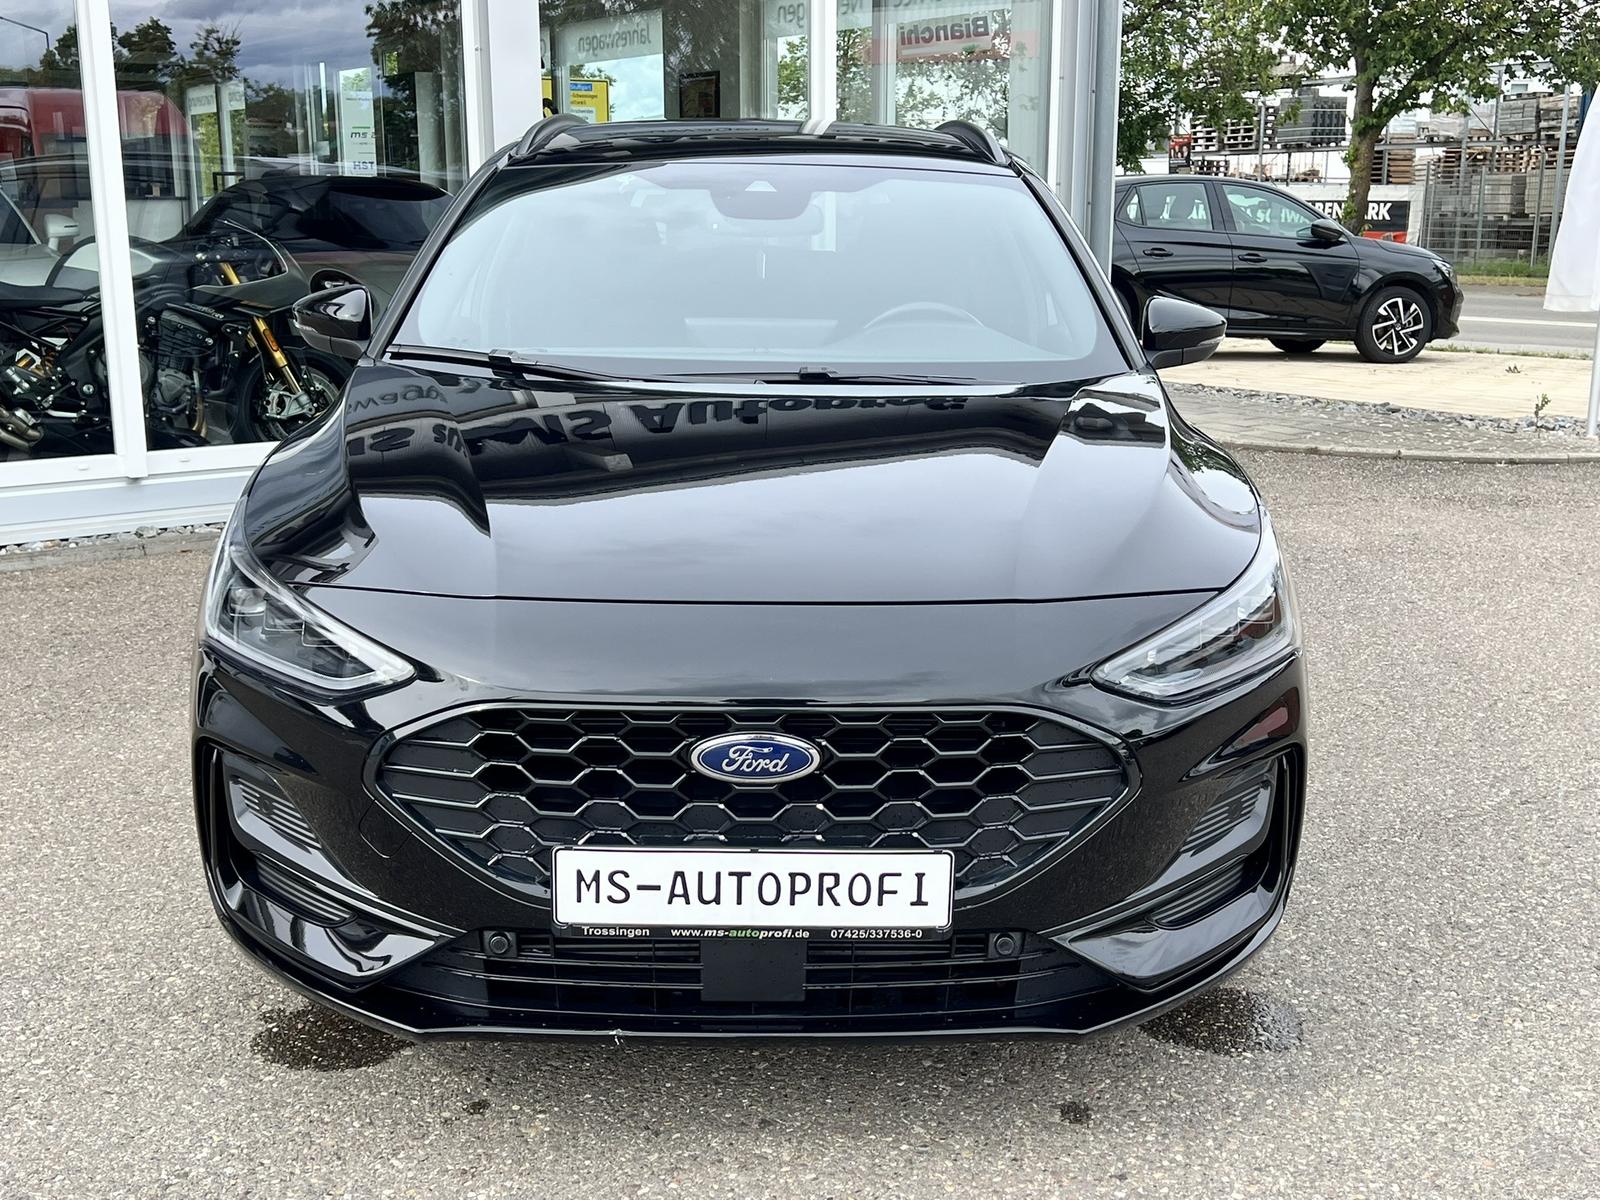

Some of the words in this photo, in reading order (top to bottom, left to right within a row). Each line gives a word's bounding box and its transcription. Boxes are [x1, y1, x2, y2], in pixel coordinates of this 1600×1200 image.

[721, 746, 788, 773] Ford
[576, 869, 929, 906] MS-AUTOPROFI
[582, 926, 650, 938] Trossingen
[671, 927, 810, 939] www.ms-autoprofi.de
[830, 929, 923, 940] 07425/337536-0
